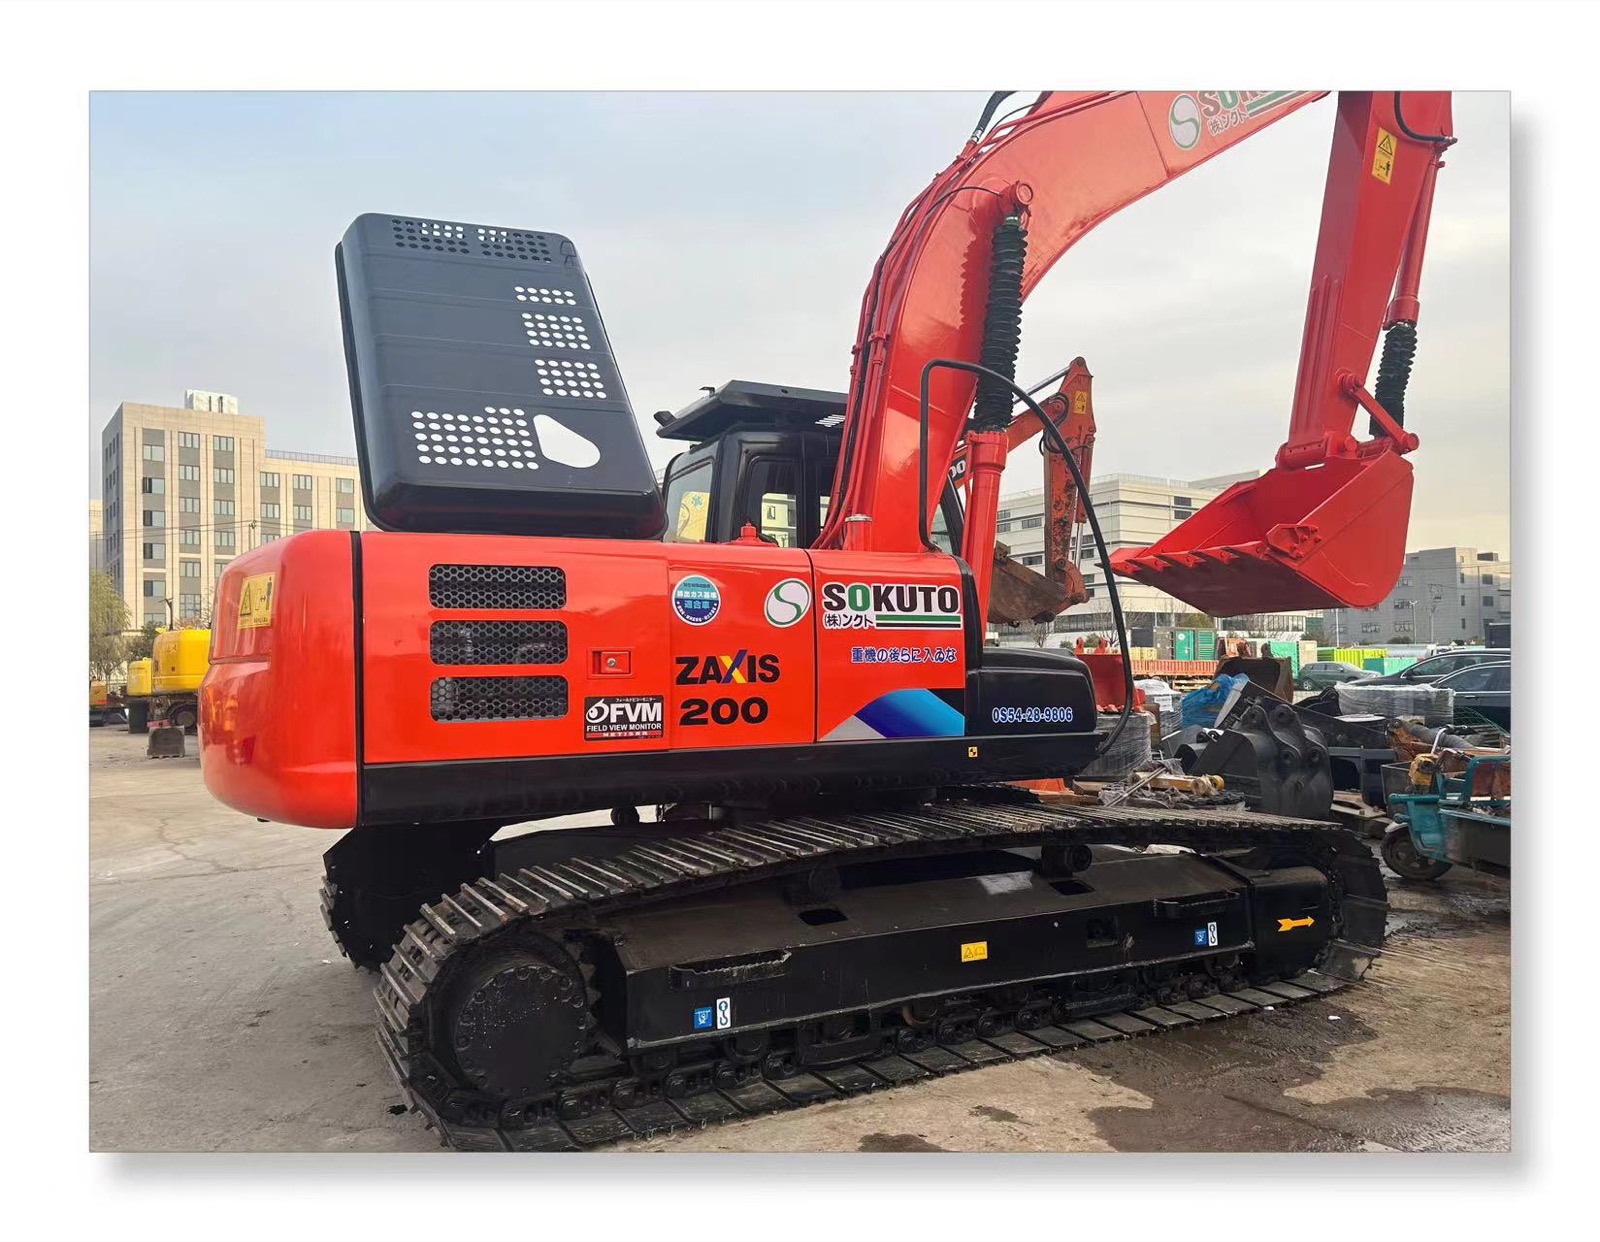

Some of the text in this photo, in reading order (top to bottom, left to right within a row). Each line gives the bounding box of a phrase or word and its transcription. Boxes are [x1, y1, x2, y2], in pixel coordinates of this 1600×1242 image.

[823, 583, 959, 613] SOKUTO
[675, 649, 780, 685] ZAXIS
[609, 702, 662, 723] FVM
[679, 697, 768, 725] 200
[586, 722, 662, 732] FIELD VIEW MONITOR
